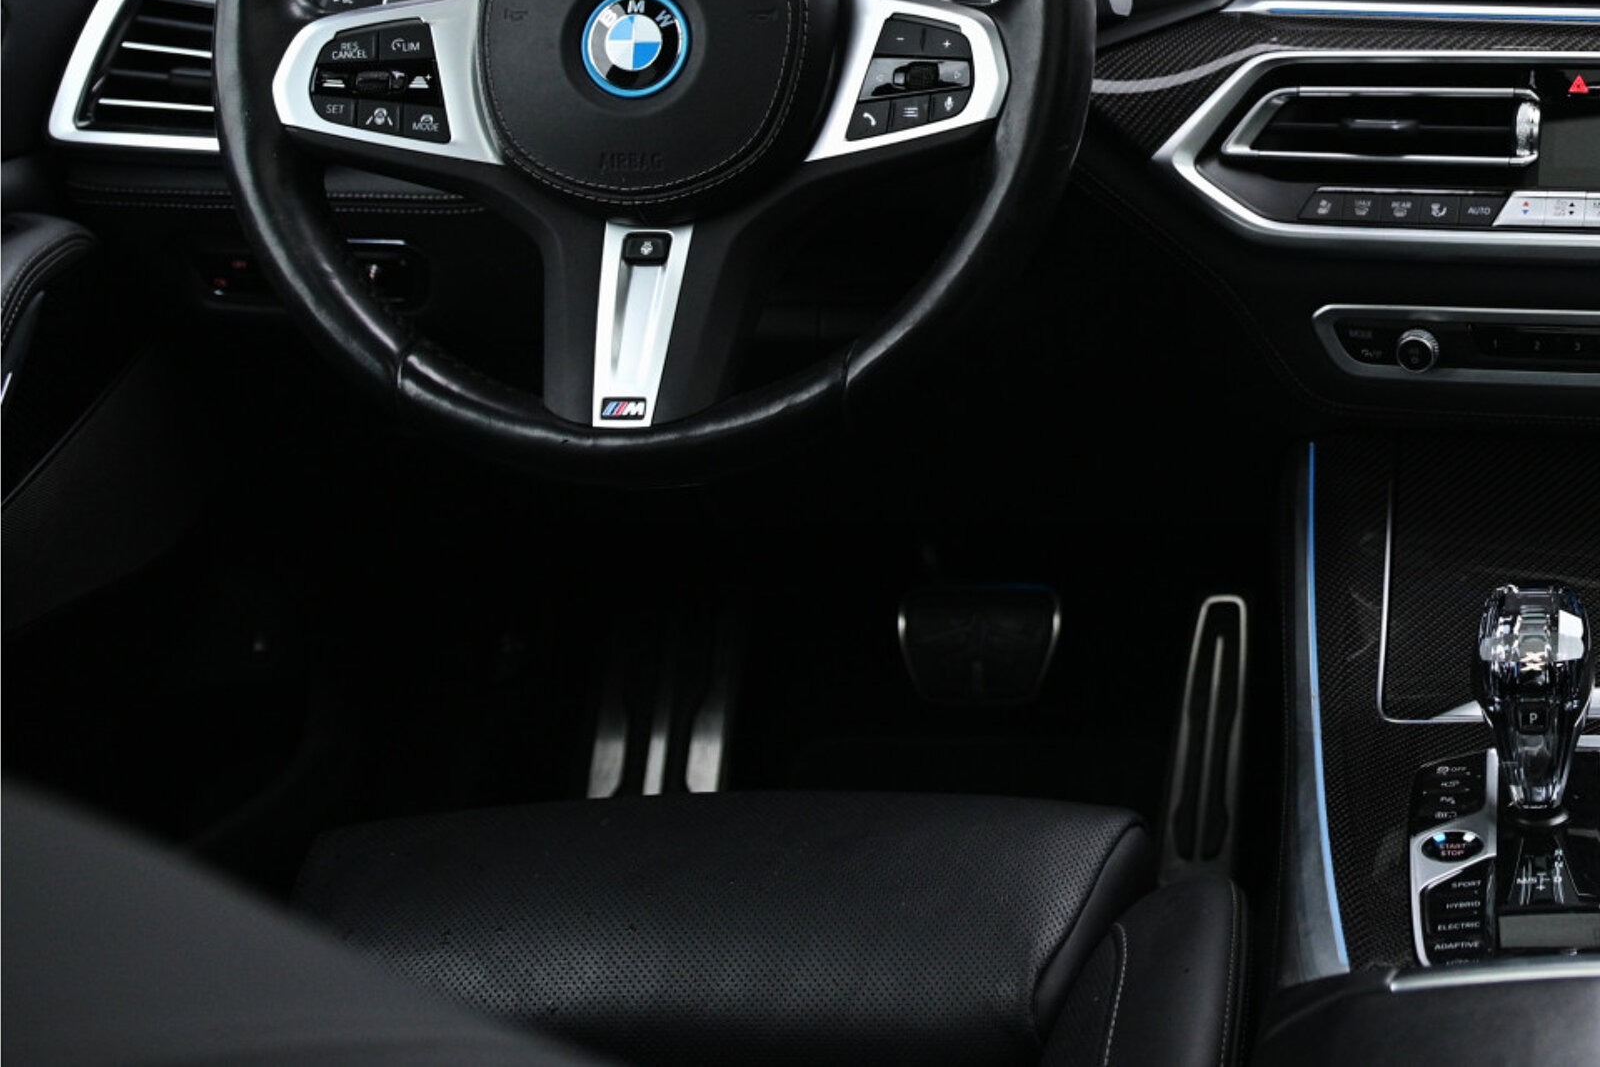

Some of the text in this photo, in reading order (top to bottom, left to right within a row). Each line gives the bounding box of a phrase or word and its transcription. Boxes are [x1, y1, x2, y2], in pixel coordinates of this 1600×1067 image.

[402, 41, 420, 52] LIM
[332, 49, 368, 60] CANCEL
[326, 104, 344, 115] SET
[412, 120, 439, 132] MODE
[600, 152, 665, 173] AIRBAG
[1467, 205, 1491, 216] AUTO
[1529, 712, 1538, 724] P
[1451, 879, 1481, 889] SPORT
[1446, 900, 1481, 910] HYBRID
[1437, 921, 1480, 931] ELECTRIC
[1434, 940, 1480, 950] ADAPTIVE
